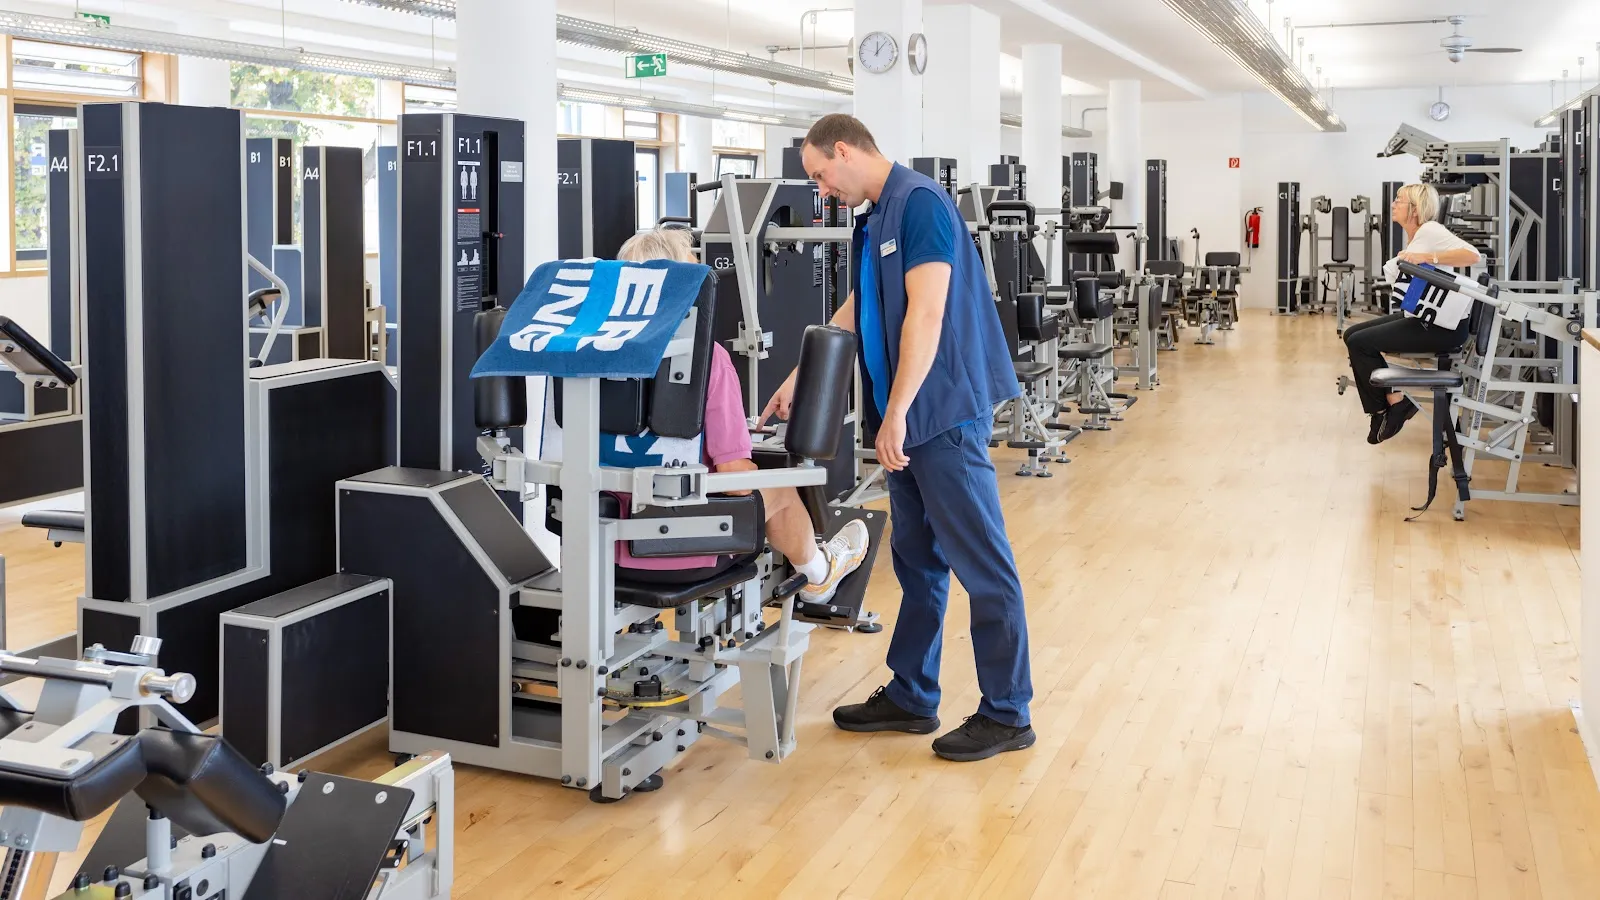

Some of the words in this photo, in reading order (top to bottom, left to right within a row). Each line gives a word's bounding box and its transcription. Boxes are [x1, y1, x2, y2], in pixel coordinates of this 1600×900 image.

[407, 140, 436, 156] F1.1
[458, 138, 480, 153] F1.1
[50, 156, 69, 172] A4
[88, 154, 118, 172] F2.1
[250, 152, 261, 163] B1
[279, 156, 291, 167] B1
[387, 161, 397, 171] B1
[304, 167, 320, 180] A4
[557, 172, 579, 185] F2.1
[714, 257, 735, 269] G3-
[509, 258, 596, 352] ING
[576, 266, 669, 352] ER
